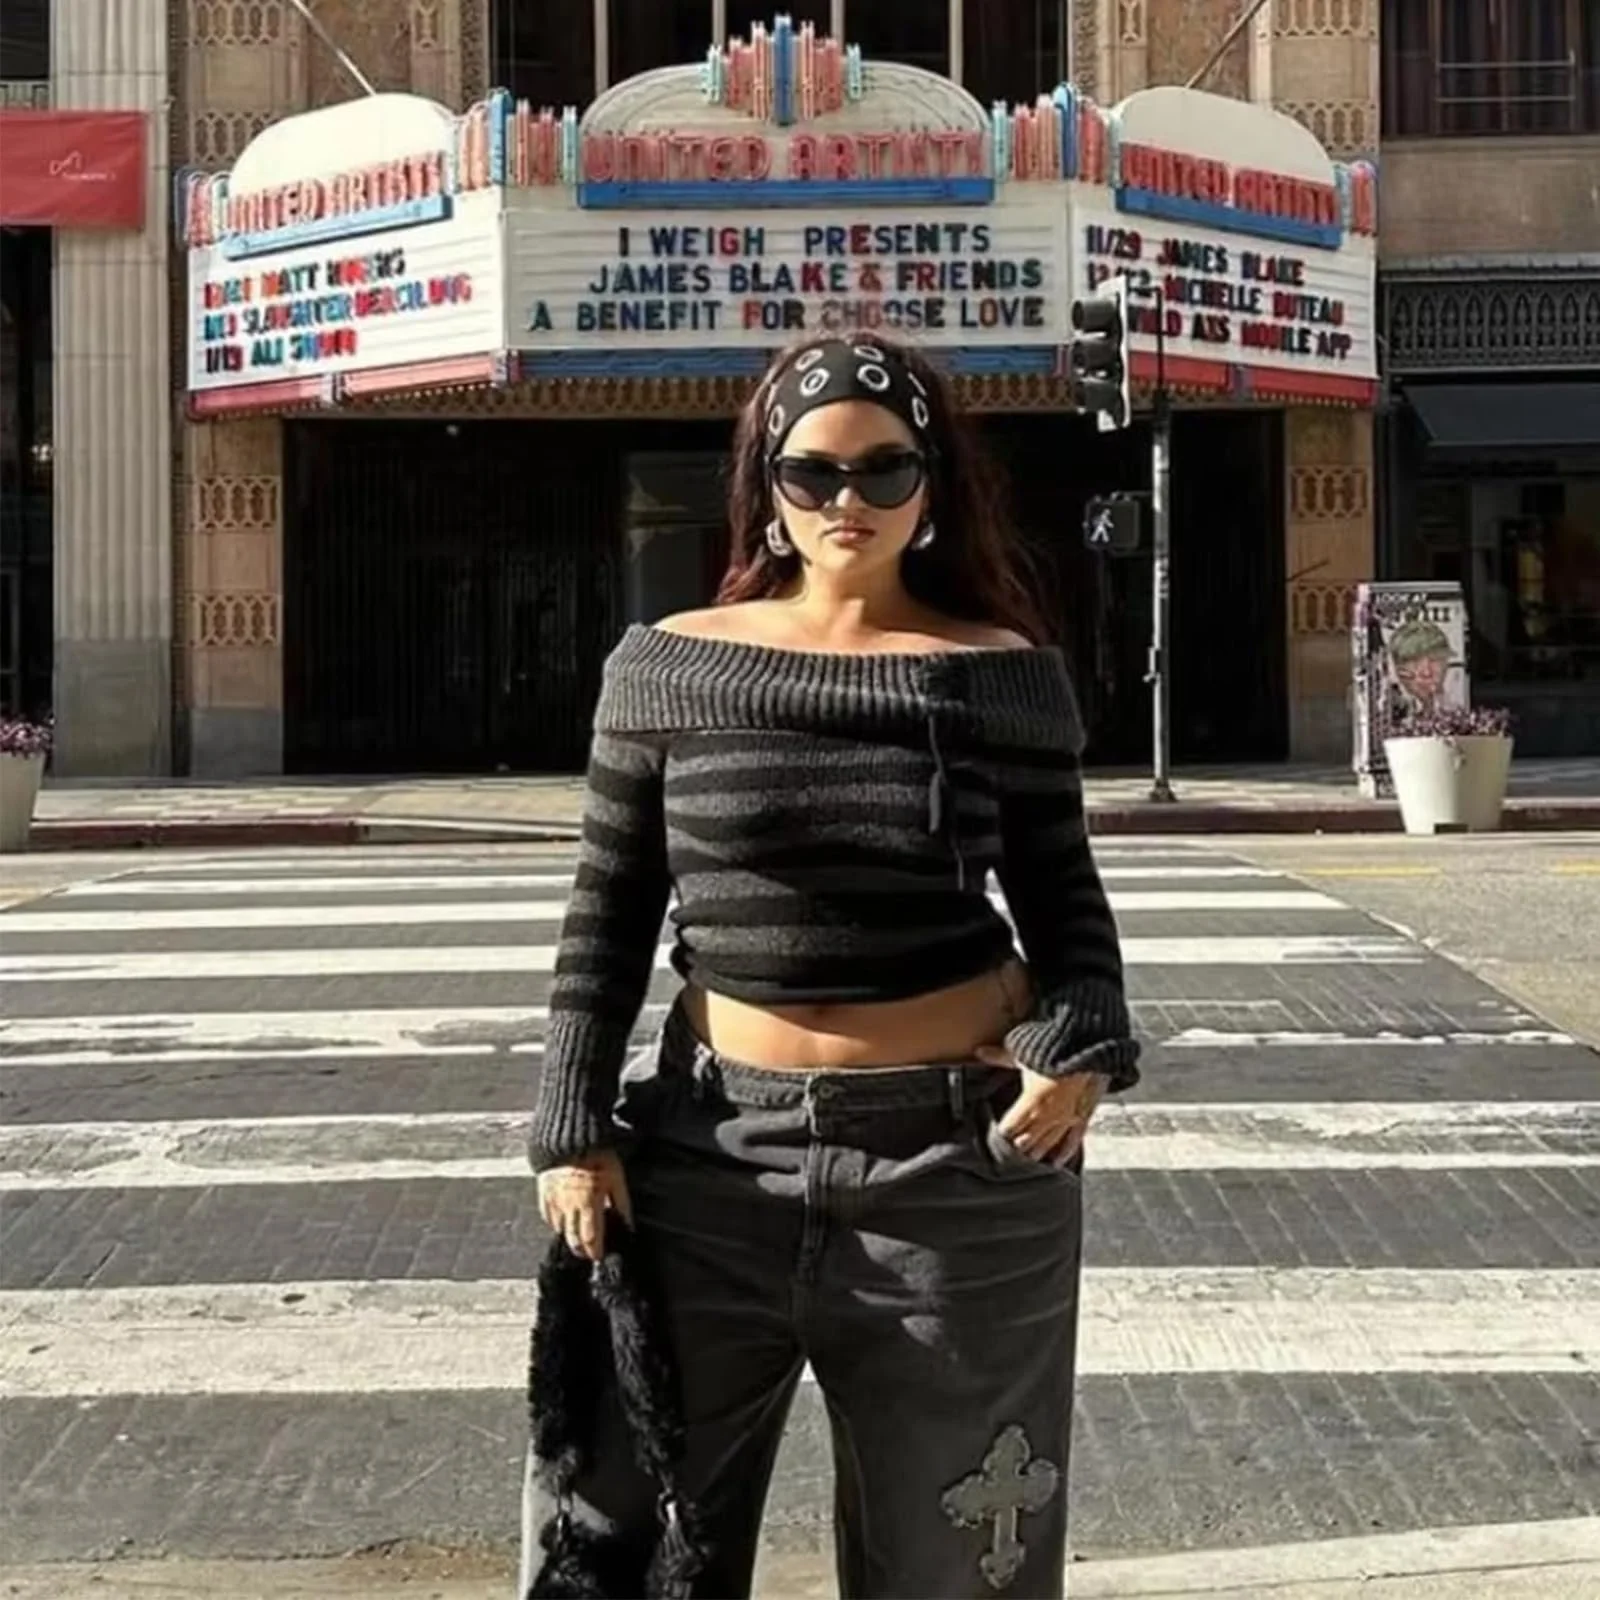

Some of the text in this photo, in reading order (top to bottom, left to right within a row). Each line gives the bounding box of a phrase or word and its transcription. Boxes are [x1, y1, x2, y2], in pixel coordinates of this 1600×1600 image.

[583, 131, 984, 181] UNITED ARTISTS
[1120, 141, 1229, 202] UNITED
[228, 179, 325, 234] UNITED
[619, 223, 990, 256] I WEIGH PRESENTS
[261, 262, 318, 297] MATT
[590, 259, 1042, 293] JAMES BLAKE & FRIENDS
[1157, 238, 1227, 273] JAMES
[1242, 252, 1304, 285] BLAKE
[1165, 275, 1262, 314] MICHELLE
[528, 297, 1044, 331] A BENEFIT FOR CHOOSE LOVE
[1317, 333, 1351, 360] APP
